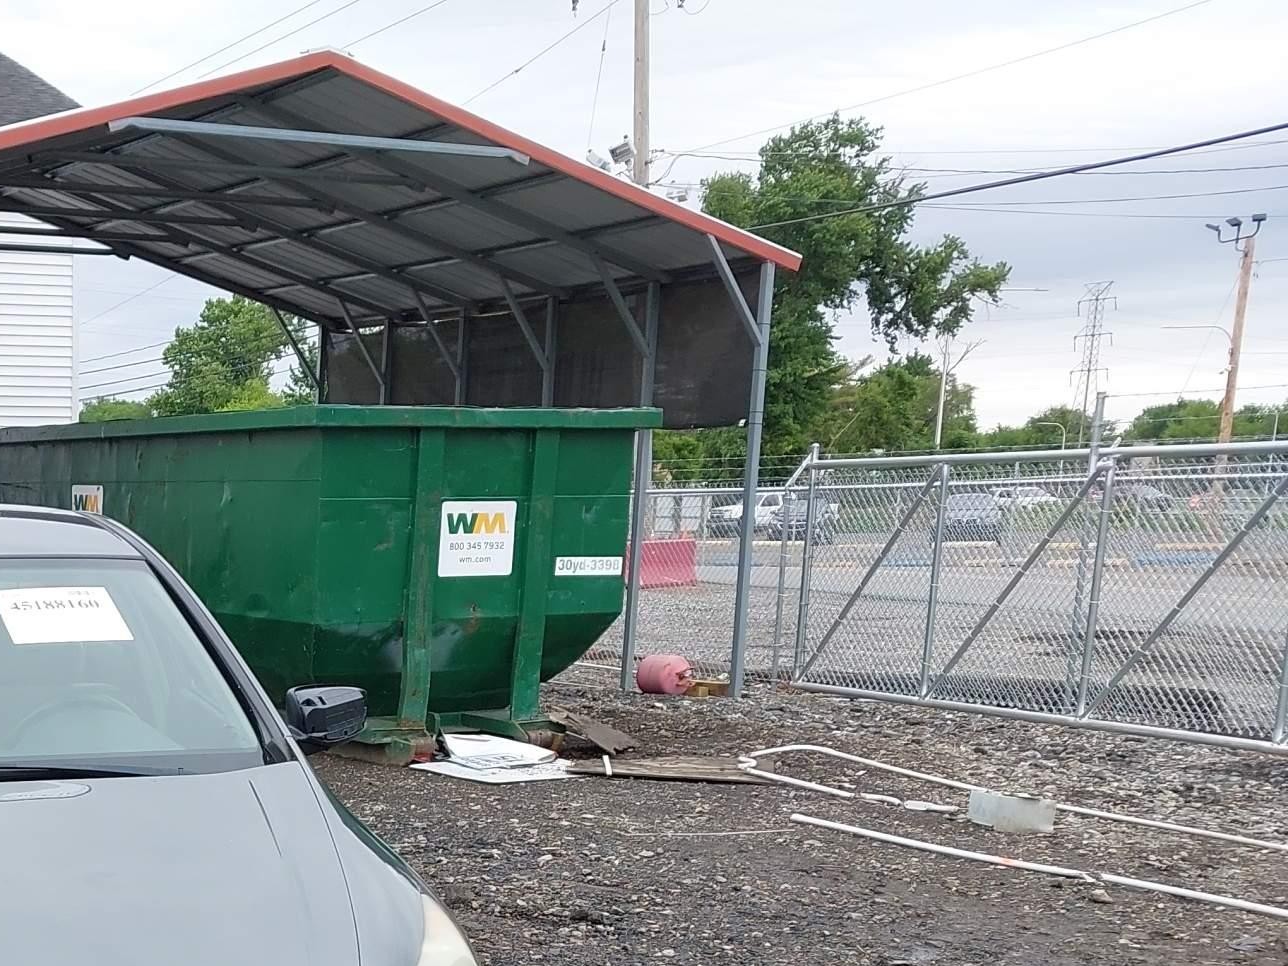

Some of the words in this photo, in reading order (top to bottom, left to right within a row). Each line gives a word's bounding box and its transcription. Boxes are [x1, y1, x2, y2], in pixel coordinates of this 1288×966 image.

[74, 494, 99, 512] WM
[447, 512, 506, 534] WM
[449, 542, 465, 551] 800
[466, 541, 482, 550] 345
[483, 541, 505, 550] 7932
